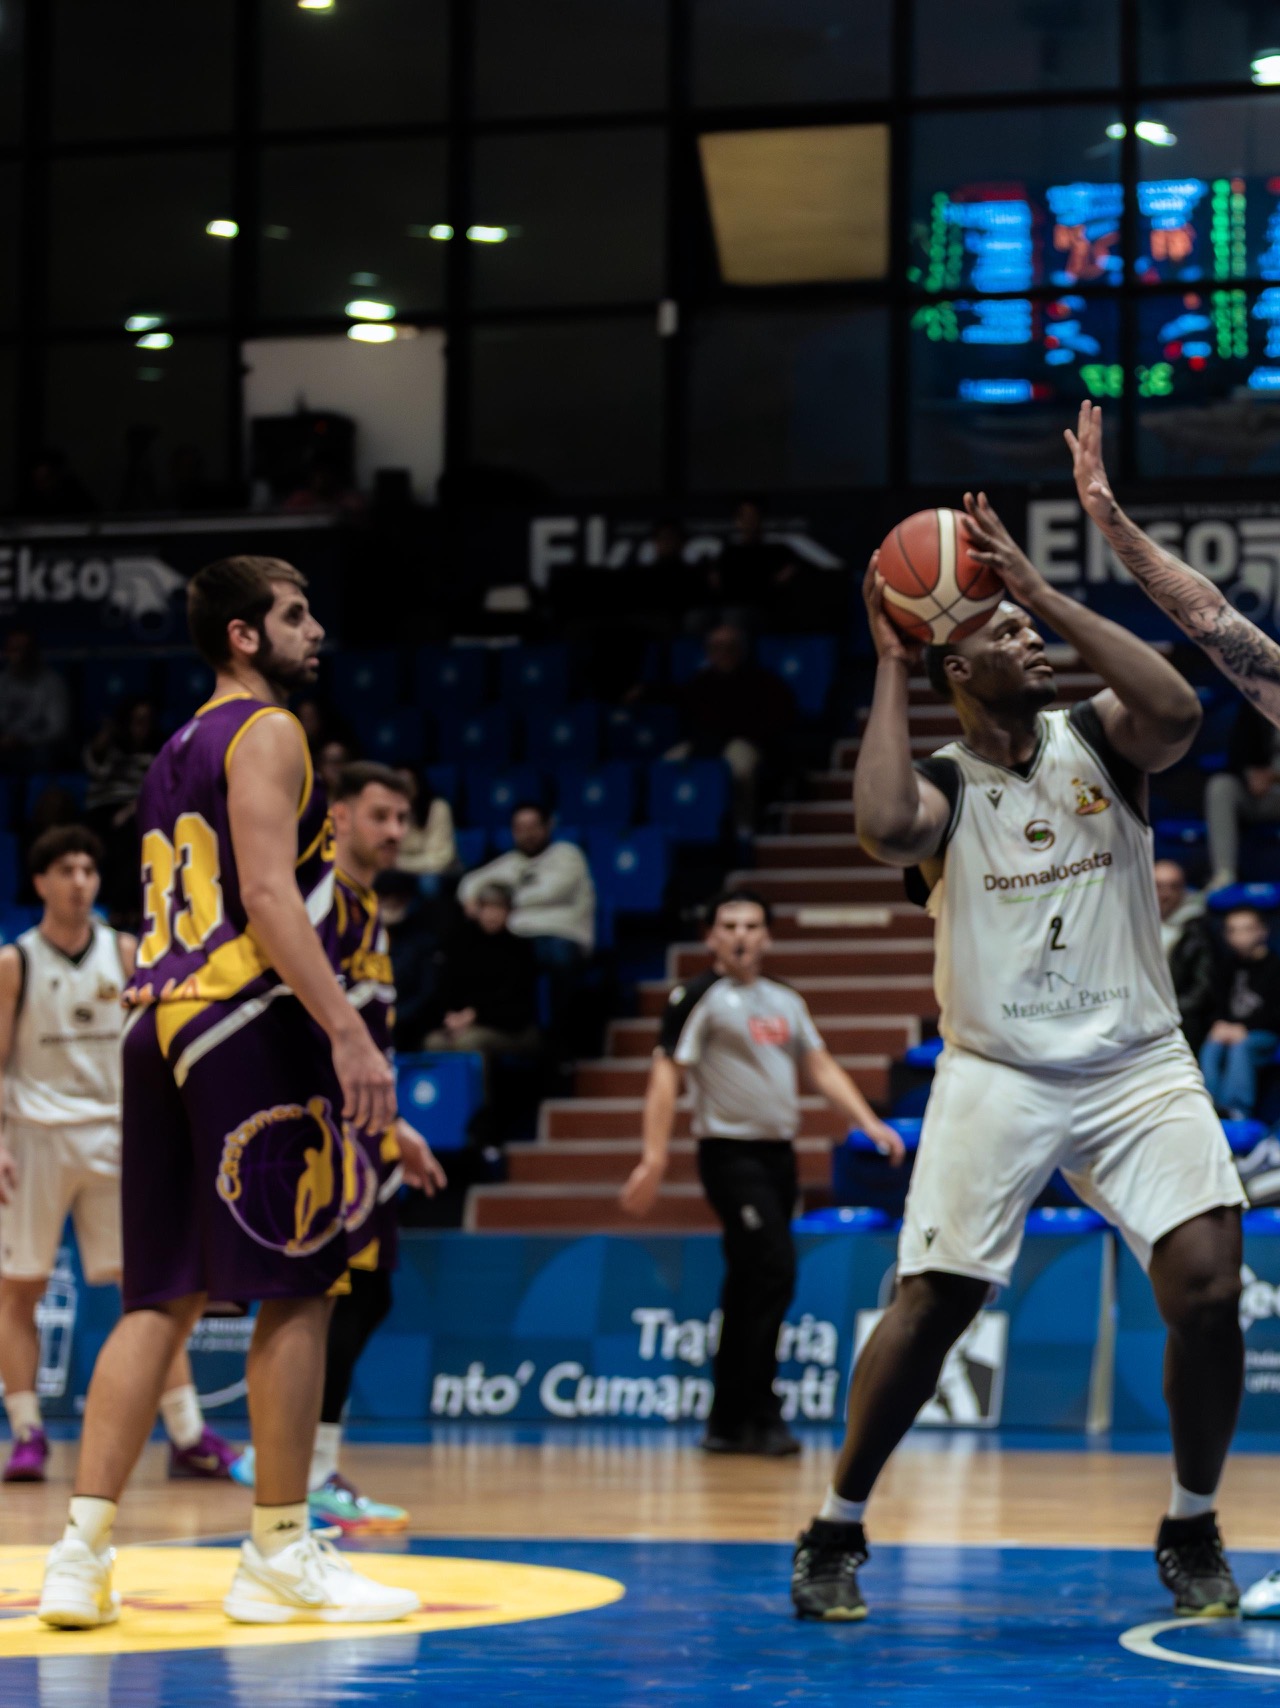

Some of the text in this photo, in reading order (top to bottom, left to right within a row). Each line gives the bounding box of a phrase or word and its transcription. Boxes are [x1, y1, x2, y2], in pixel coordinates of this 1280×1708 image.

[136, 812, 223, 968] 33
[983, 852, 1113, 891] Donnalucata
[1050, 916, 1067, 951] 2
